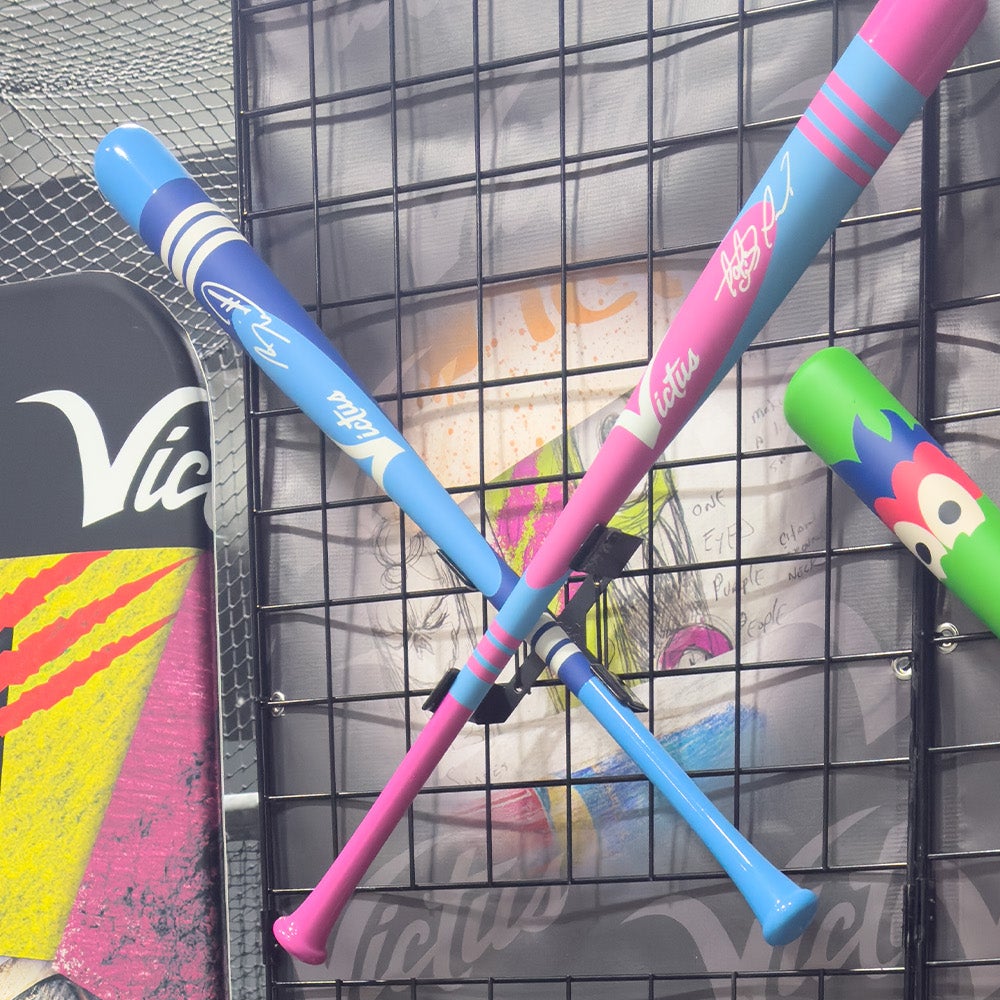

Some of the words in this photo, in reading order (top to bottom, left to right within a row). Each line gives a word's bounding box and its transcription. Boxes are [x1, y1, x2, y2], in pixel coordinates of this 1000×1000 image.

[326, 390, 406, 492] Victus
[616, 347, 700, 449] Victus
[16, 386, 213, 530] Vic
[692, 489, 725, 517] ONE
